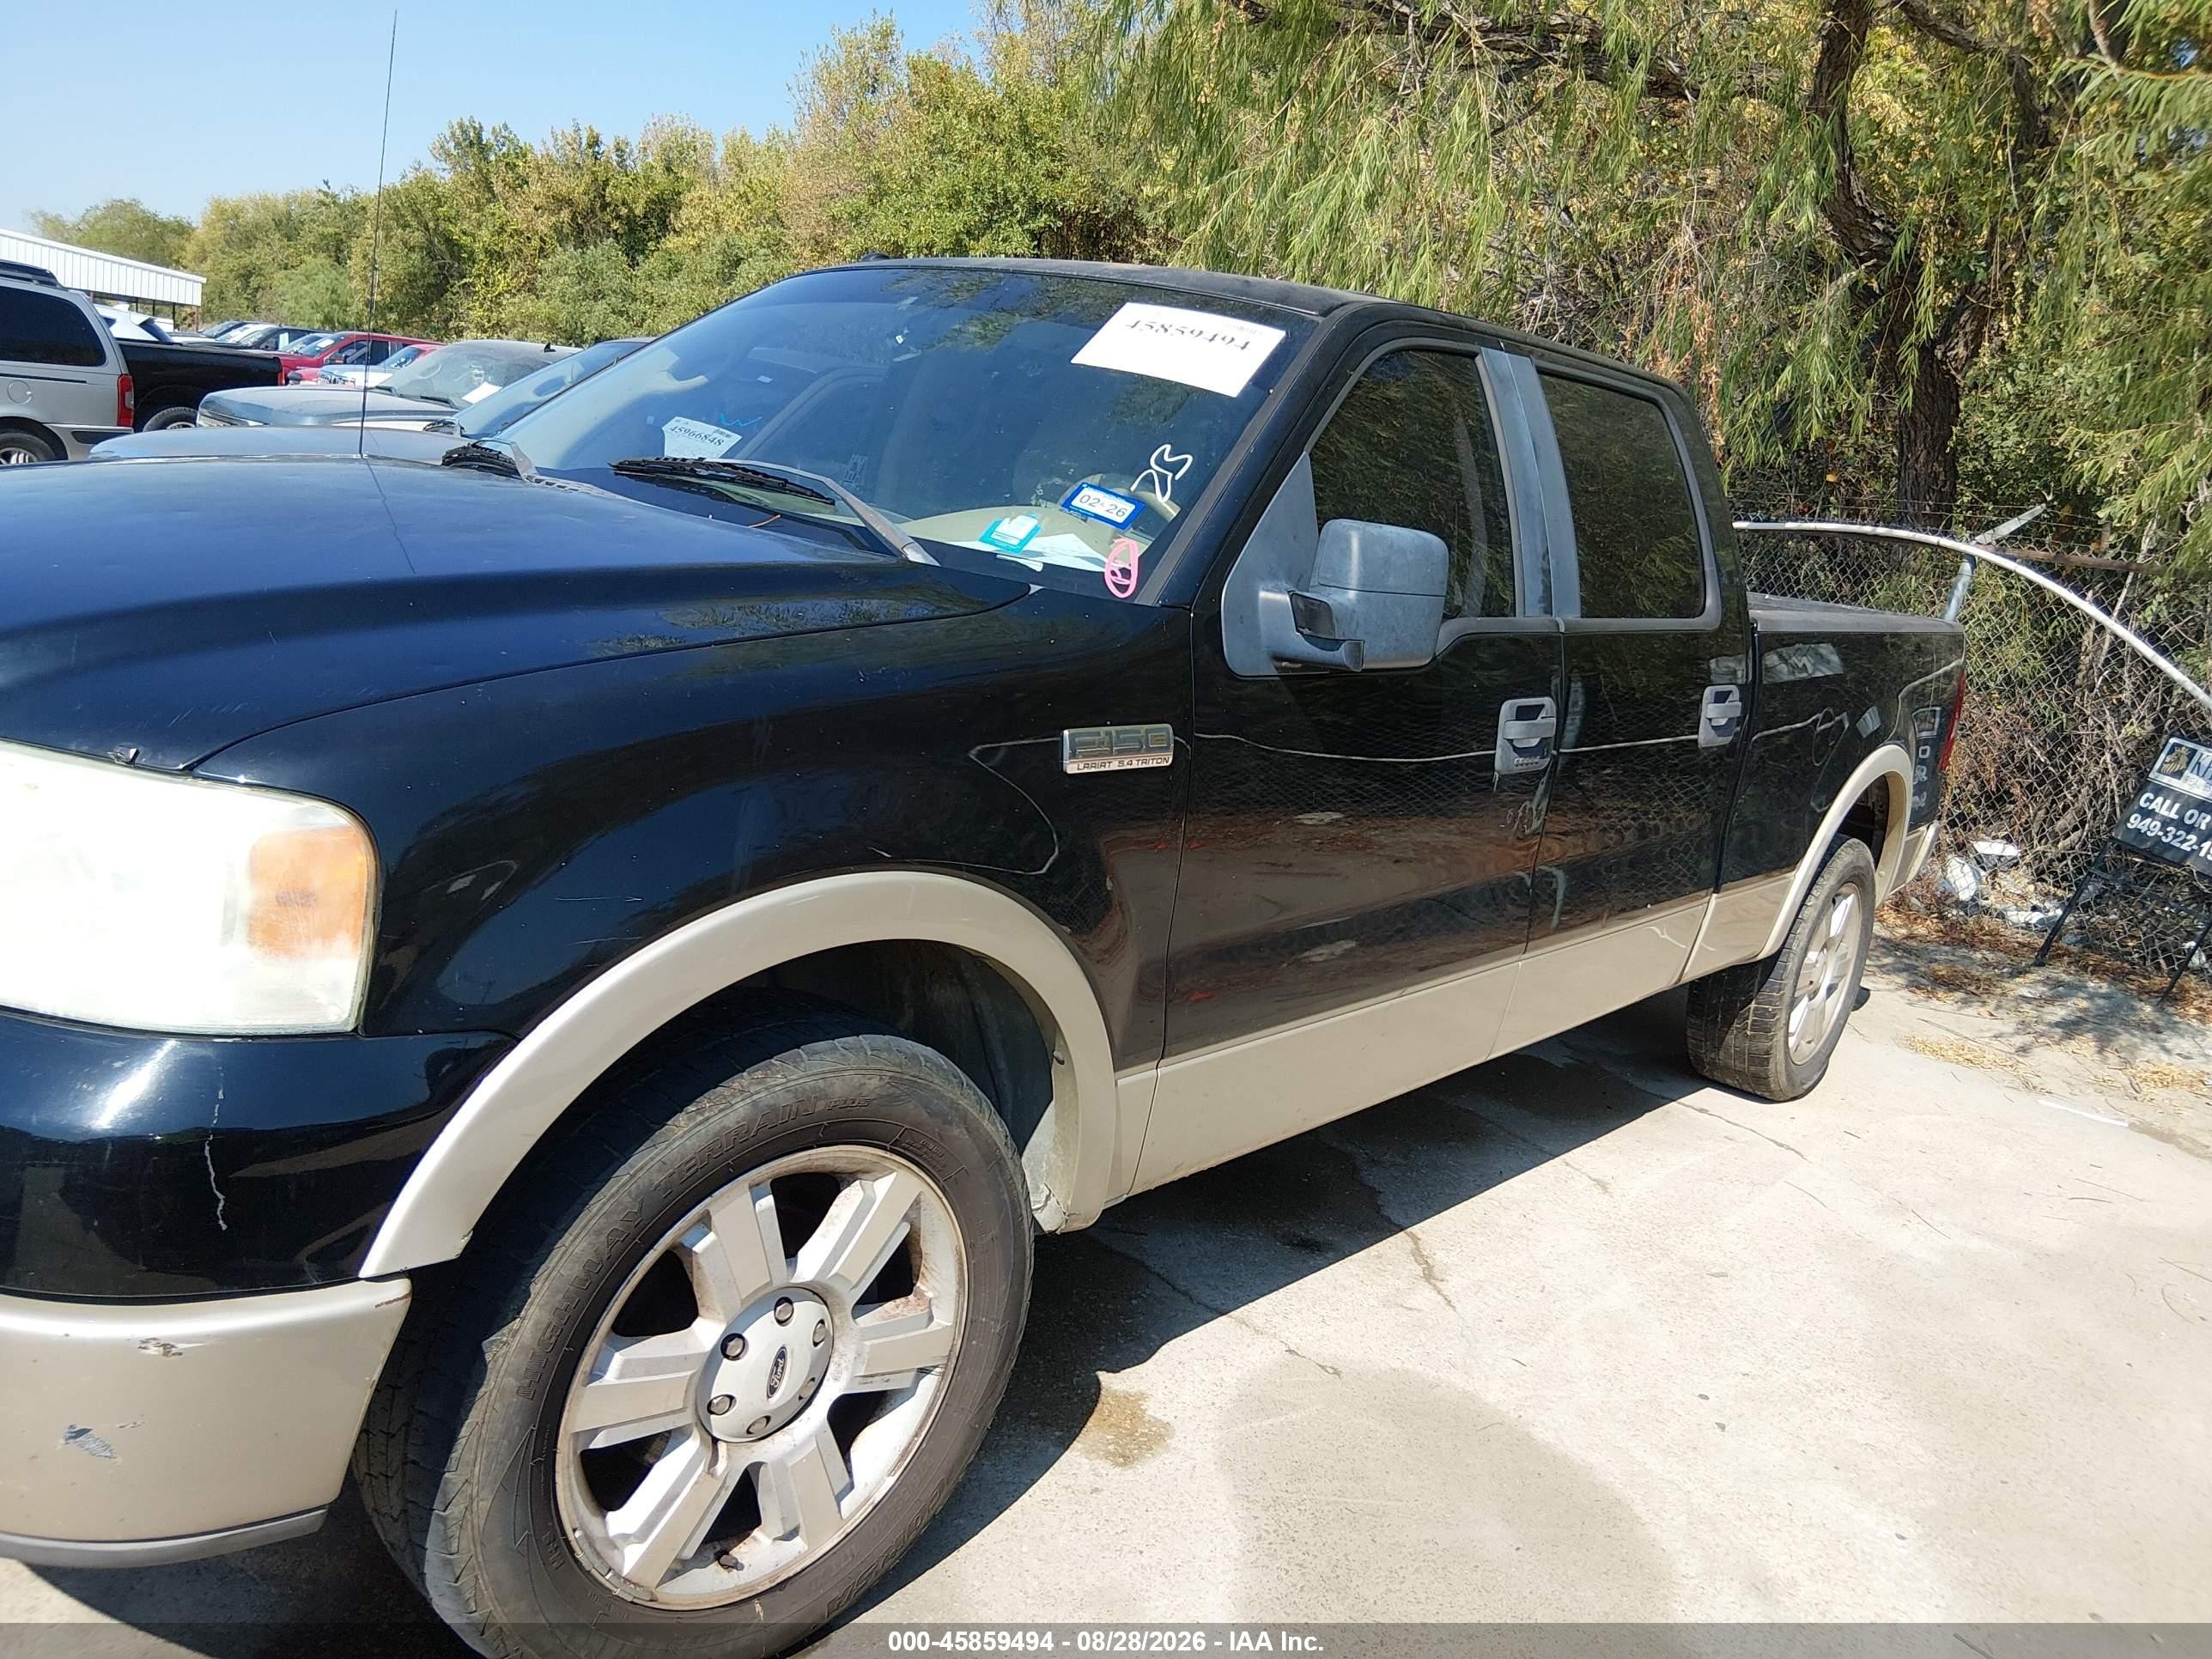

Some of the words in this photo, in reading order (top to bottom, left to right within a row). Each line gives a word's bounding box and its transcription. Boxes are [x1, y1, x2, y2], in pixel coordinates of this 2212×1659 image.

[1124, 319, 1250, 350] 45859494
[670, 426, 725, 447] 45966848
[1076, 760, 1114, 772] LARIAT
[1133, 755, 1171, 768] TRITON
[2139, 792, 2181, 820] CALL
[2184, 809, 2212, 830] OR
[651, 1095, 818, 1199] TERRAIN
[769, 1357, 786, 1389] Ford
